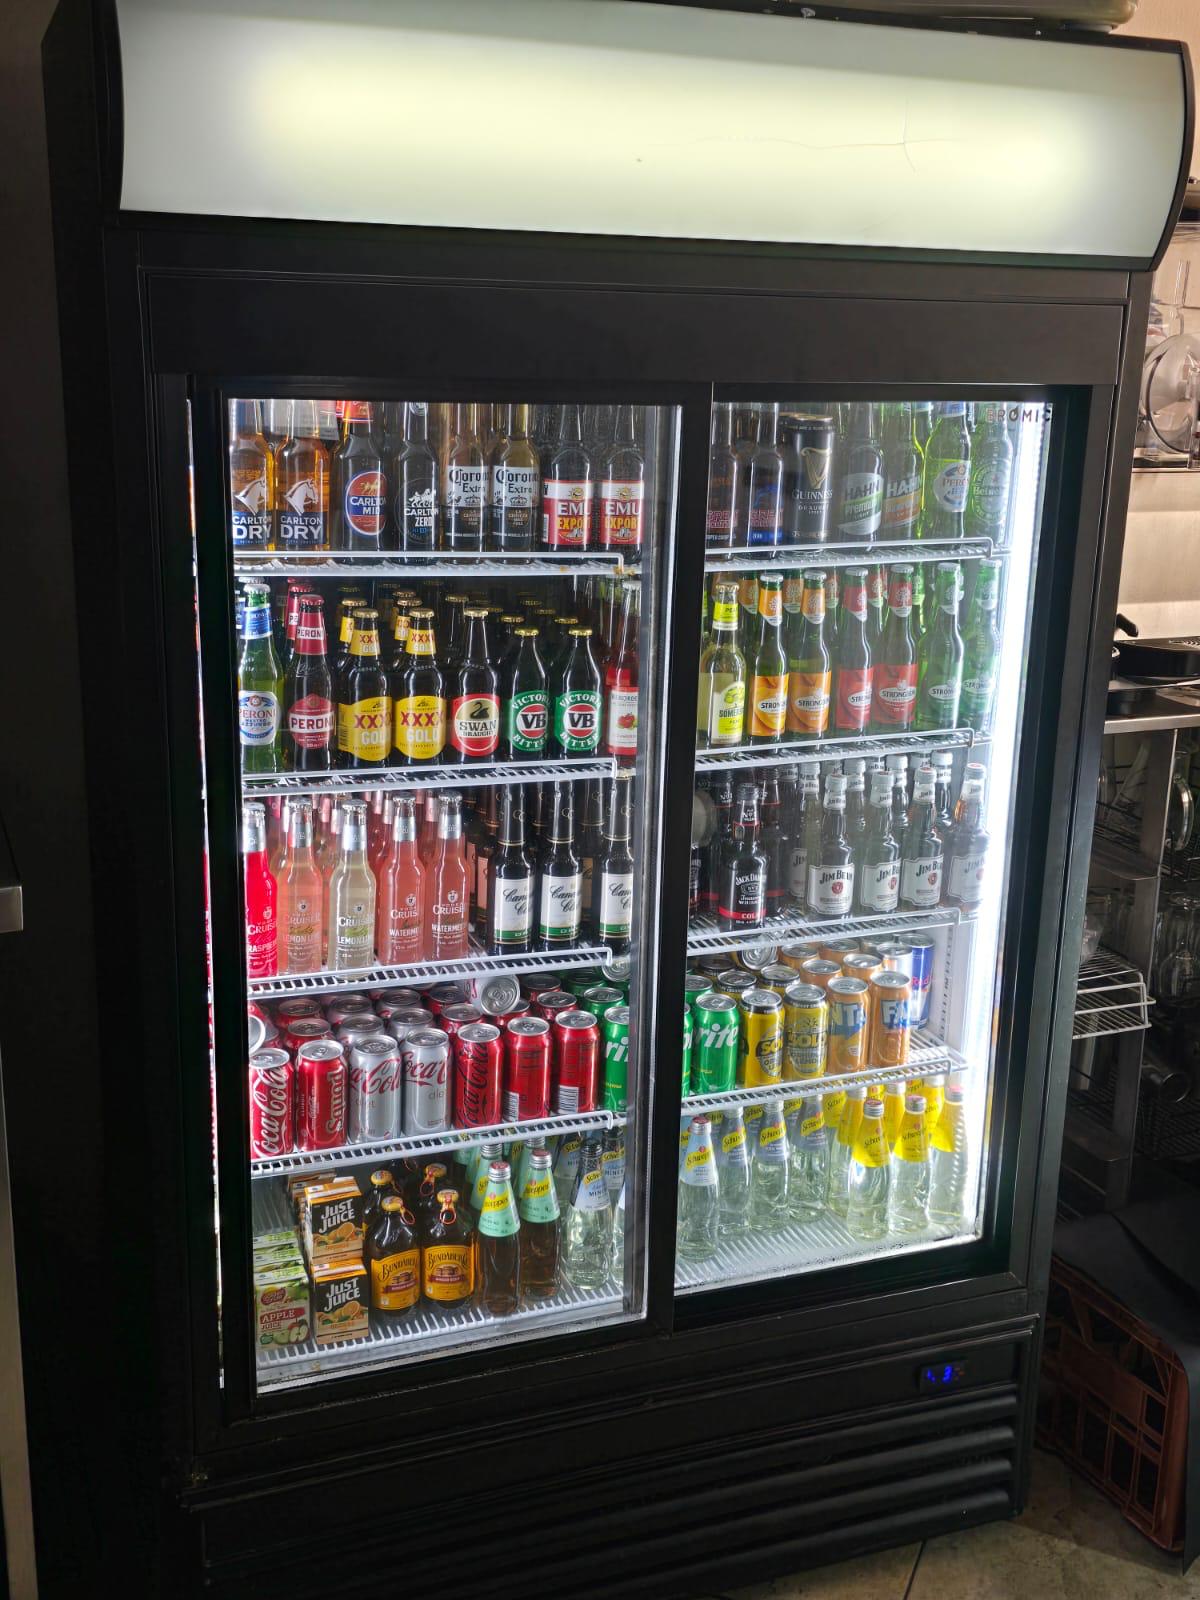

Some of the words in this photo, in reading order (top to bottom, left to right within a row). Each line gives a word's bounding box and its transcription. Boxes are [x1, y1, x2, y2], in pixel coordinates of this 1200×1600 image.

[605, 501, 640, 515] EMU
[280, 515, 323, 525] CARLTON
[280, 524, 323, 540] DRY
[459, 720, 496, 732] SWAN
[520, 713, 546, 729] VB
[568, 713, 595, 728] VB
[406, 728, 438, 743] GOLD
[819, 871, 835, 884] JIM
[916, 864, 932, 877] JIM
[252, 1066, 289, 1158] Coca-Cola
[320, 1199, 353, 1220] JUST
[318, 1208, 355, 1234] JUICE
[326, 1277, 359, 1298] JUST
[323, 1287, 361, 1312] JUICE
[262, 1309, 296, 1323] APPLE
